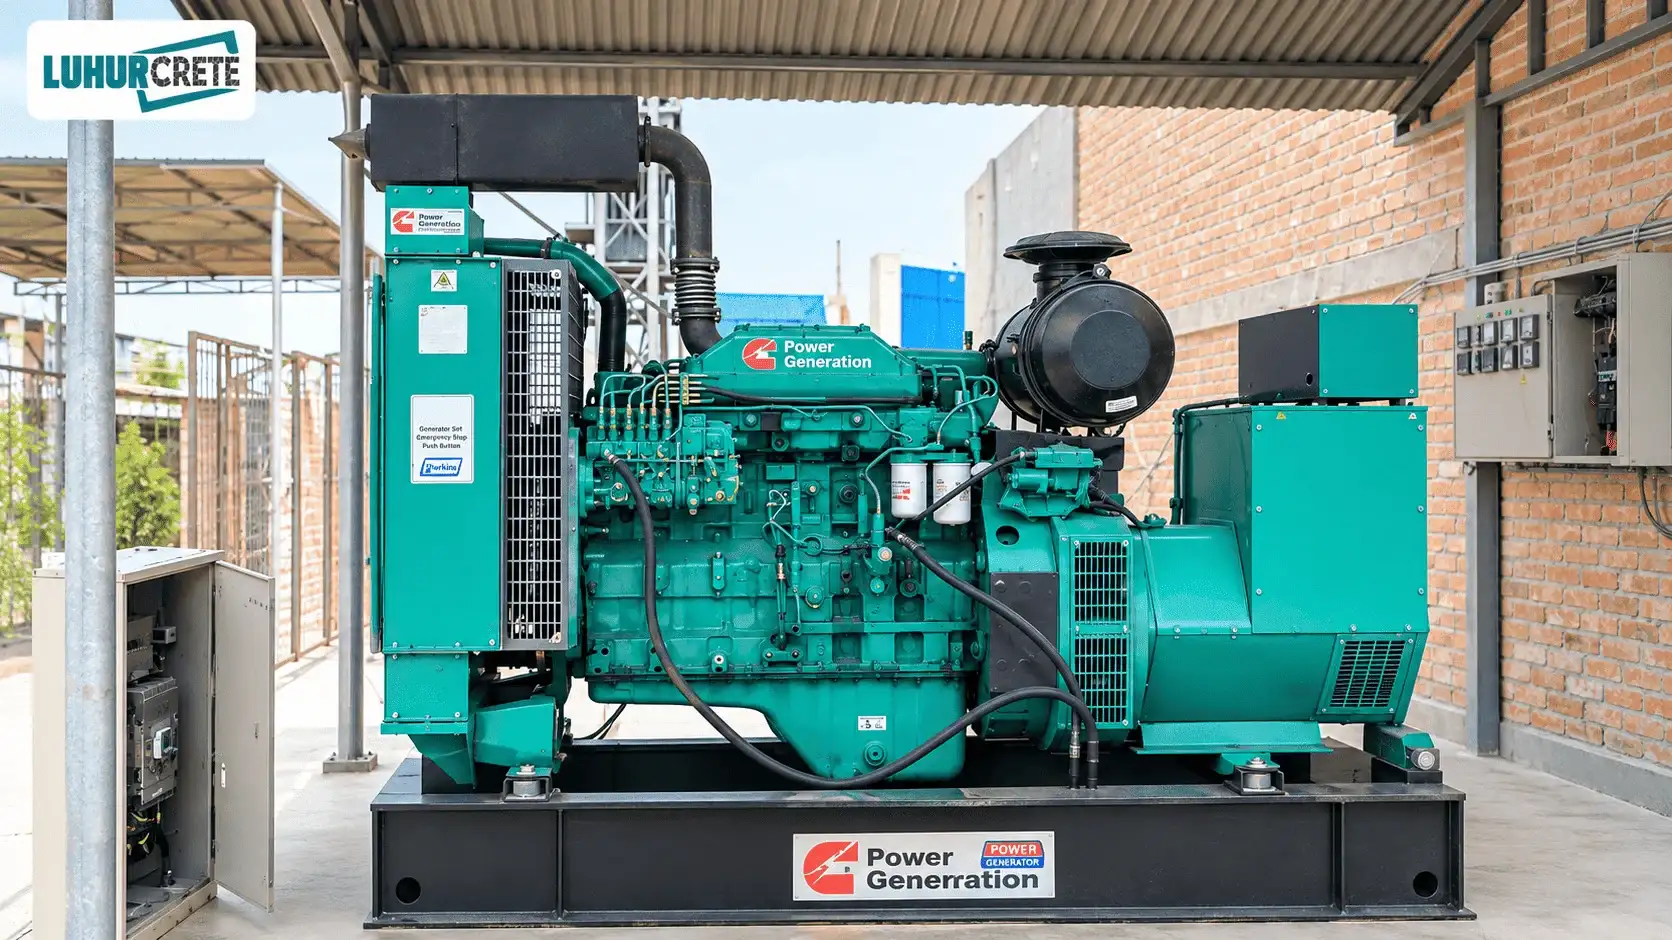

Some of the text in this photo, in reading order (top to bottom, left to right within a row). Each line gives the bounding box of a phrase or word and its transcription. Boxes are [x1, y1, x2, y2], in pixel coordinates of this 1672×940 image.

[784, 340, 835, 353] Power
[784, 355, 872, 369] Generation
[990, 844, 1037, 855] POWER
[867, 848, 954, 867] Power
[985, 857, 1040, 867] GENERATOR
[867, 869, 1039, 890] Generration
